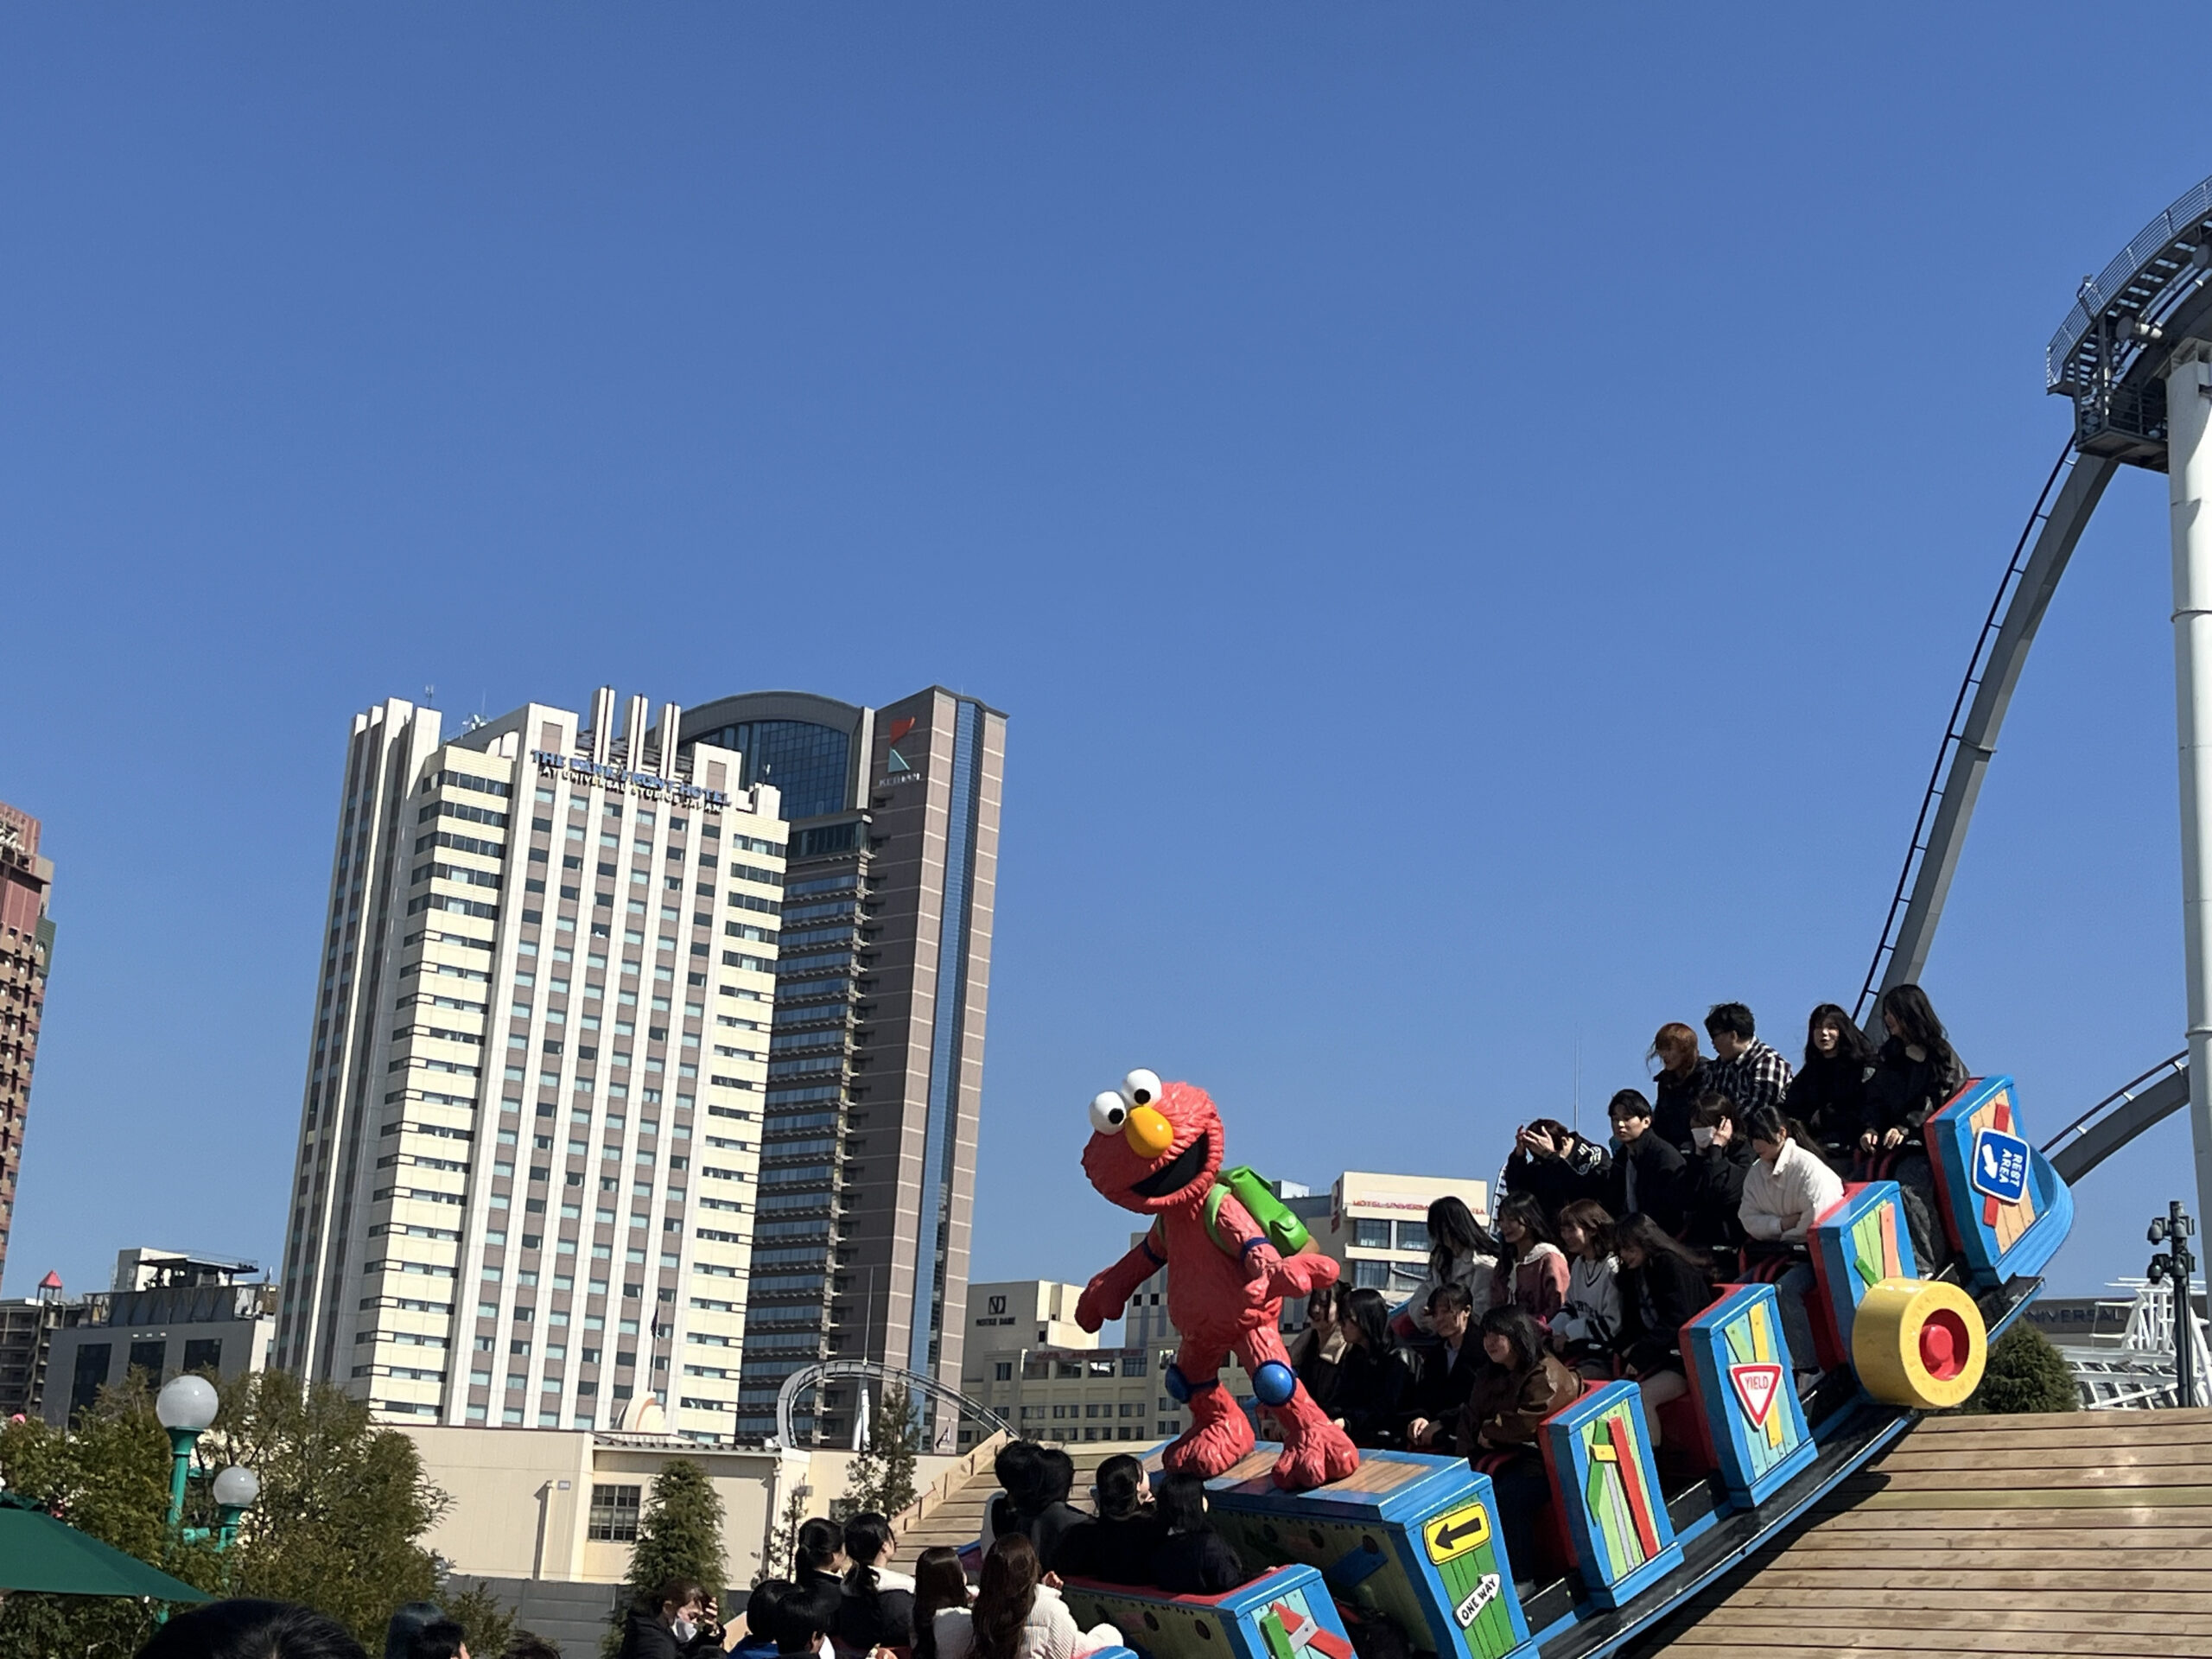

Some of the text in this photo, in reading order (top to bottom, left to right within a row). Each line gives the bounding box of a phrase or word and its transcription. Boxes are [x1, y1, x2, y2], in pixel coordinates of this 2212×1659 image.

[530, 749, 566, 768] THE
[679, 782, 732, 807] HOTEL
[539, 766, 558, 779] AT
[1999, 1147, 2012, 1183] AREA
[2010, 1154, 2024, 1187] REST
[1385, 1202, 1430, 1211] UNIVERSA
[2023, 1309, 2124, 1323] NIVERSAL
[1745, 1376, 1769, 1390] YIELD
[1461, 1579, 1496, 1621] ONE WAY
